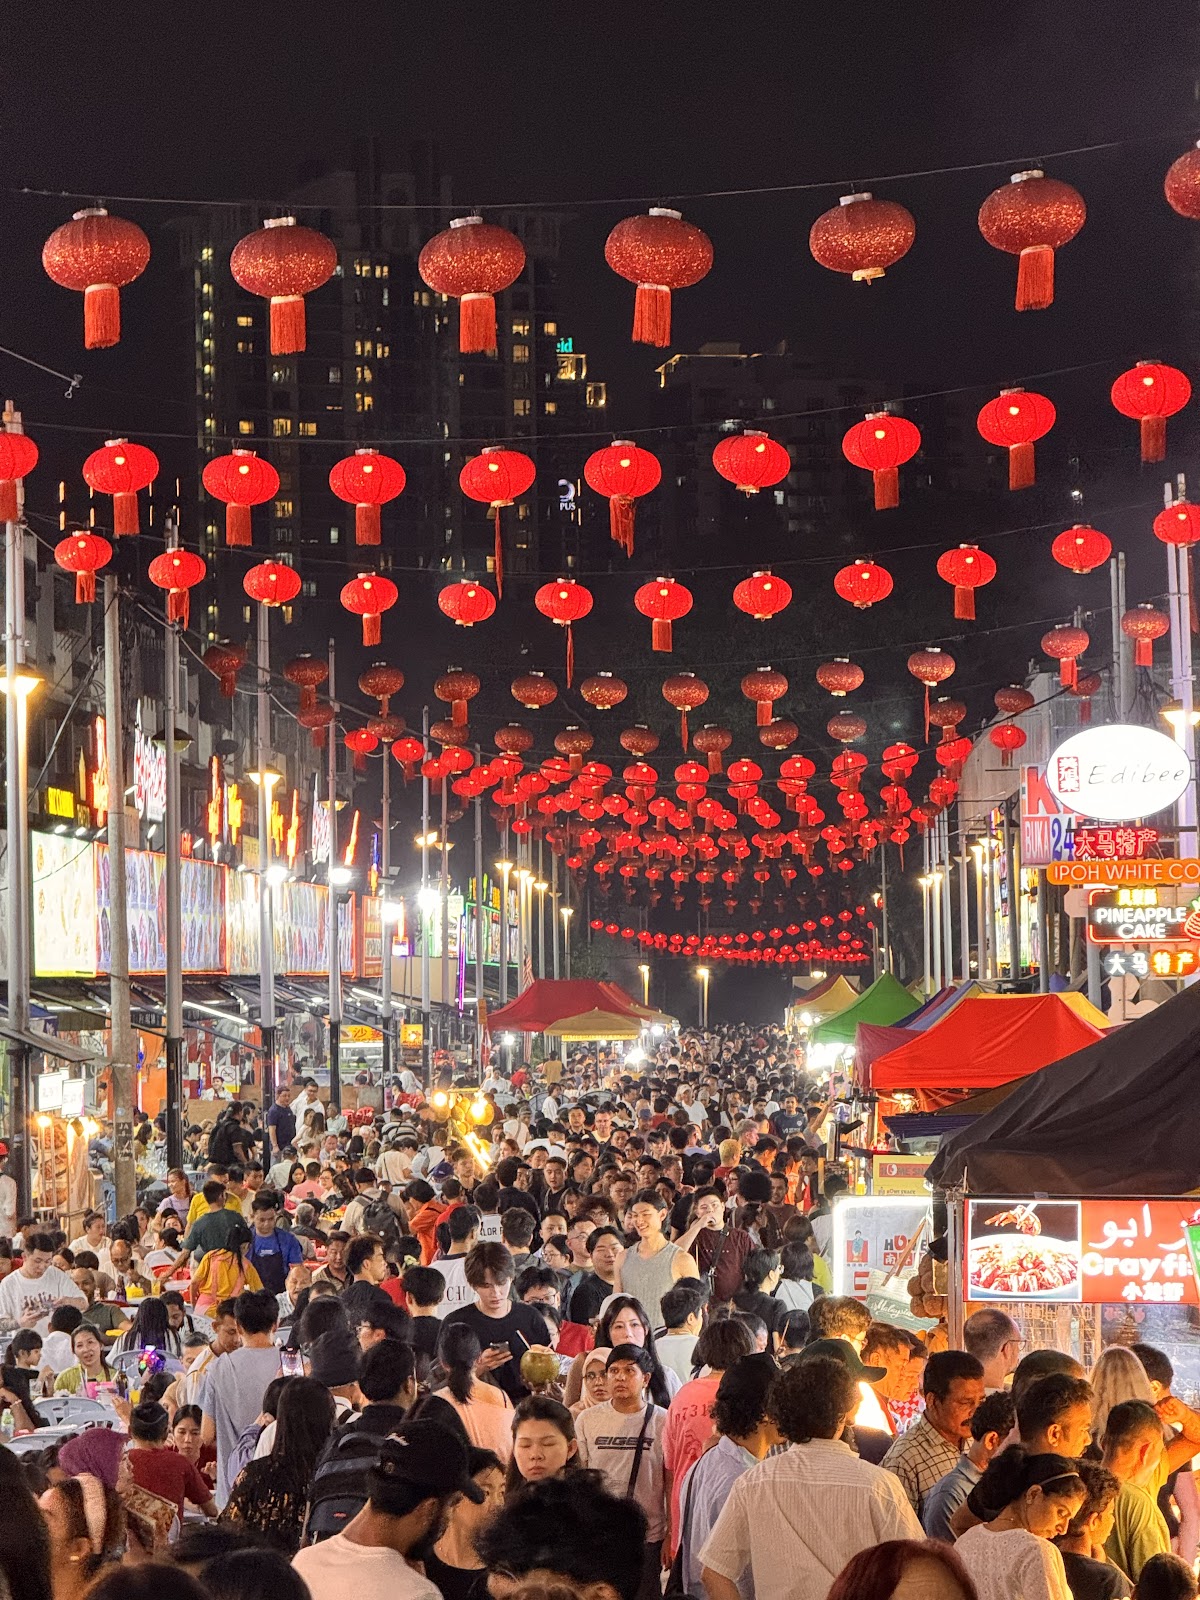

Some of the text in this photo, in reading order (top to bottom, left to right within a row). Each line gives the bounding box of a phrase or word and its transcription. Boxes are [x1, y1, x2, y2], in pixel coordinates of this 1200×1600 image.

[1088, 763, 1185, 785] Edibee
[1025, 820, 1050, 860] BUKA
[1075, 829, 1158, 857] 大马特产
[1054, 864, 1100, 881] IPOH
[1105, 863, 1163, 880] WHITE
[1096, 907, 1187, 923] PINEAPPLE
[1118, 923, 1167, 939] CAKE
[1108, 951, 1194, 975] 大马特产
